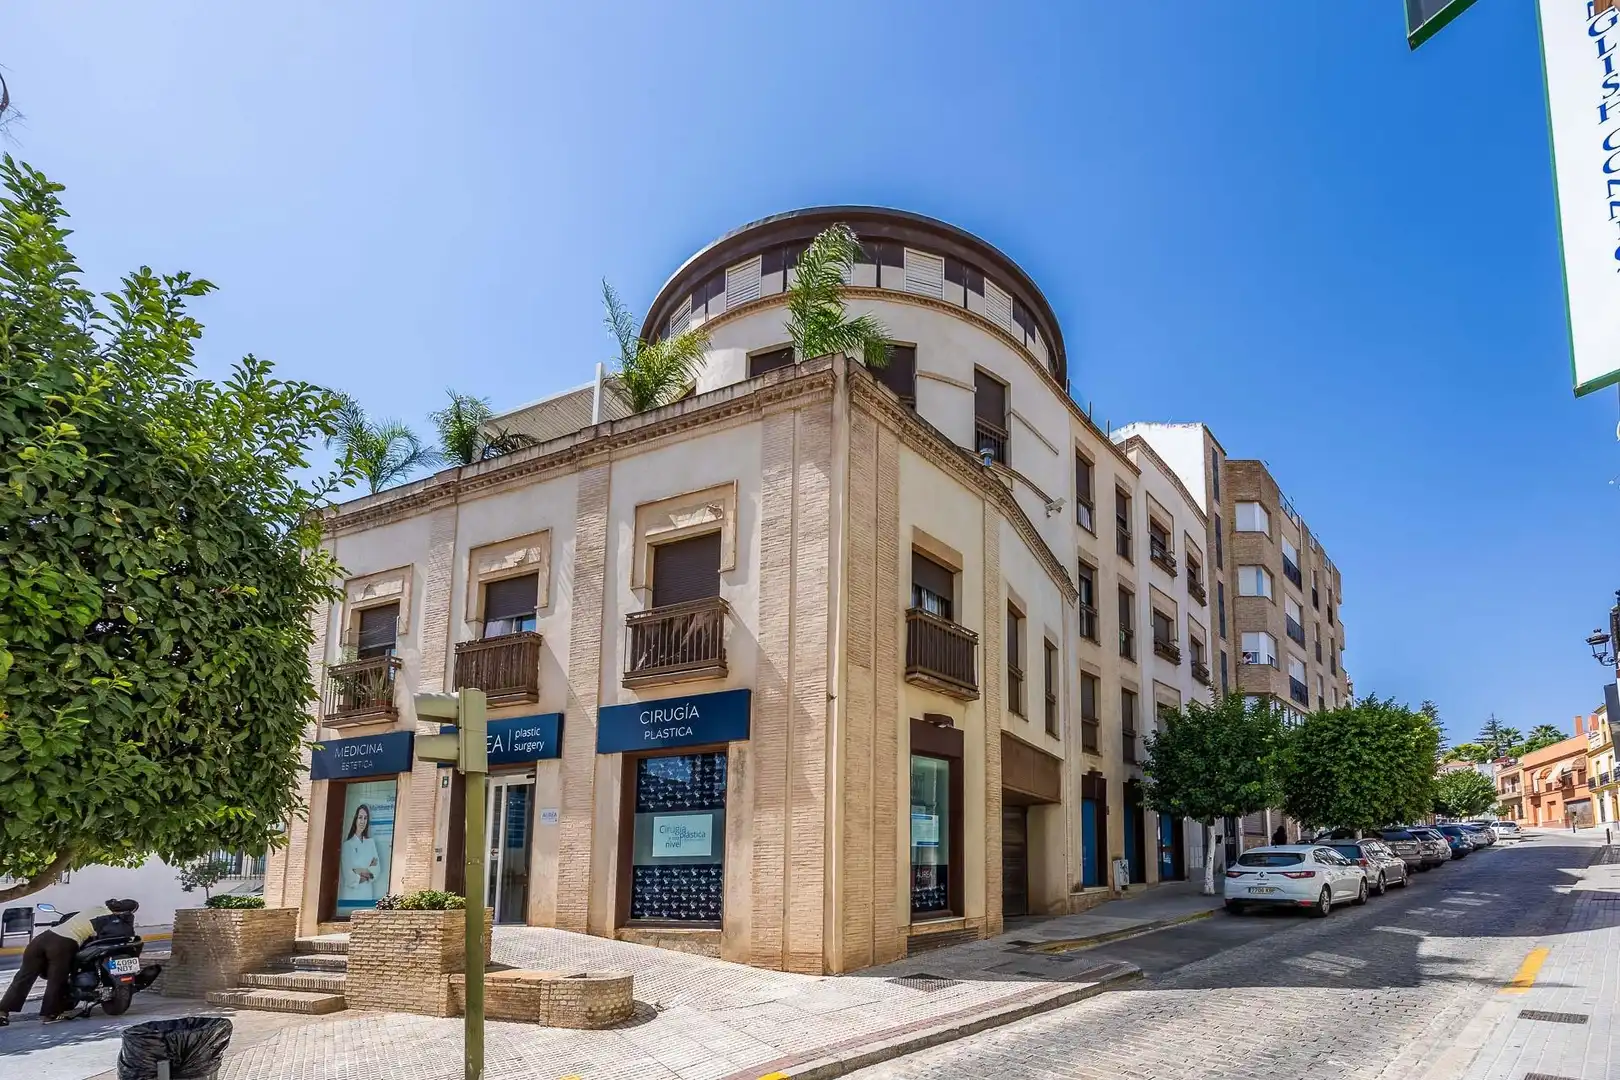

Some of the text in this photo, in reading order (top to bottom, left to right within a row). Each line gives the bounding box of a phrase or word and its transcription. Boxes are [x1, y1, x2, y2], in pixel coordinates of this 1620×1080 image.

[1586, 1, 1620, 125] GLISH
[640, 702, 700, 725] CIRUGÍA
[514, 726, 541, 741] plastic
[334, 742, 384, 758] MEDICINA
[486, 734, 504, 754] EA
[513, 740, 545, 753] surgery
